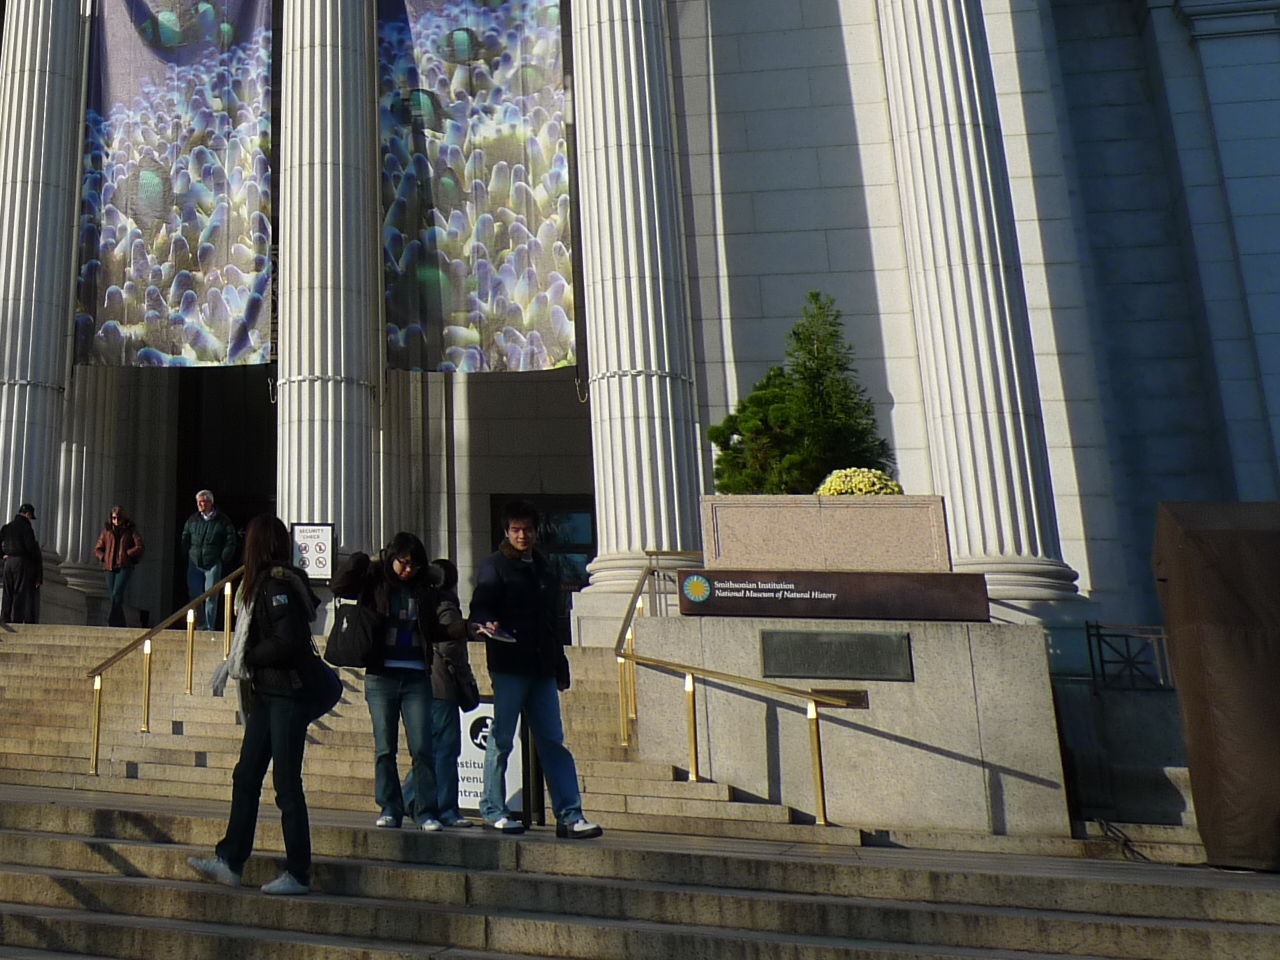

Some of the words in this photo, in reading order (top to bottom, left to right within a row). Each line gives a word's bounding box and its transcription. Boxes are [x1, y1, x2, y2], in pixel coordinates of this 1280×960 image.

[714, 581, 757, 589] Smithsonian
[758, 581, 795, 590] Institution
[715, 589, 744, 597] National
[745, 590, 775, 598] Museum
[775, 590, 783, 600] of
[783, 591, 810, 599] Natural
[811, 591, 837, 600] History
